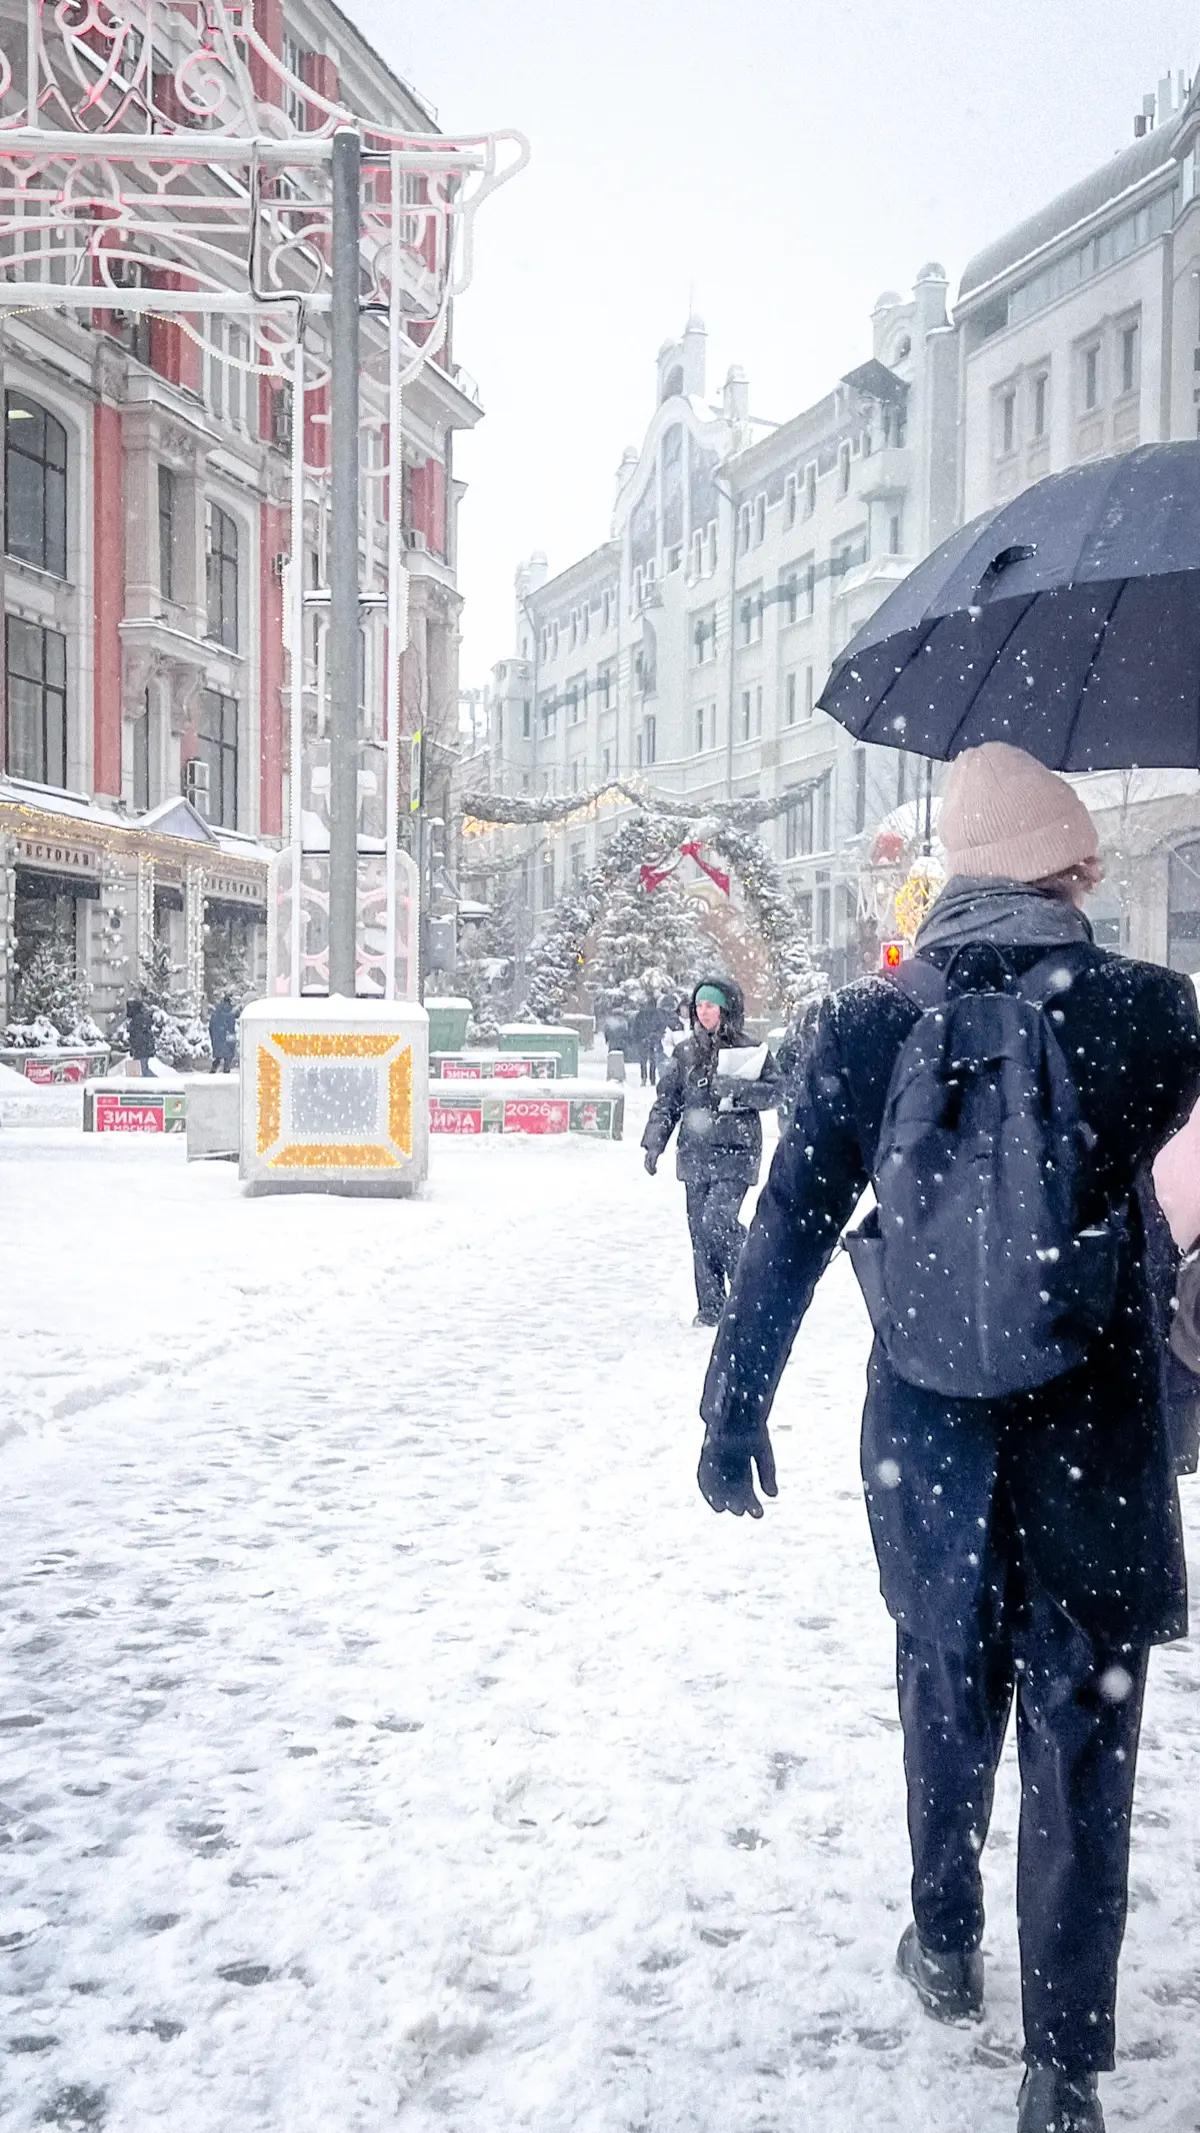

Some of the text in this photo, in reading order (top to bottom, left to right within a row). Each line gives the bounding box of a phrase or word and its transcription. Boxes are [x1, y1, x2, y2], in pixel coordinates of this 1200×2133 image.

[103, 1110, 158, 1125] ЗИМА
[505, 1104, 550, 1117] 2026
[429, 1111, 475, 1127] ИМА
